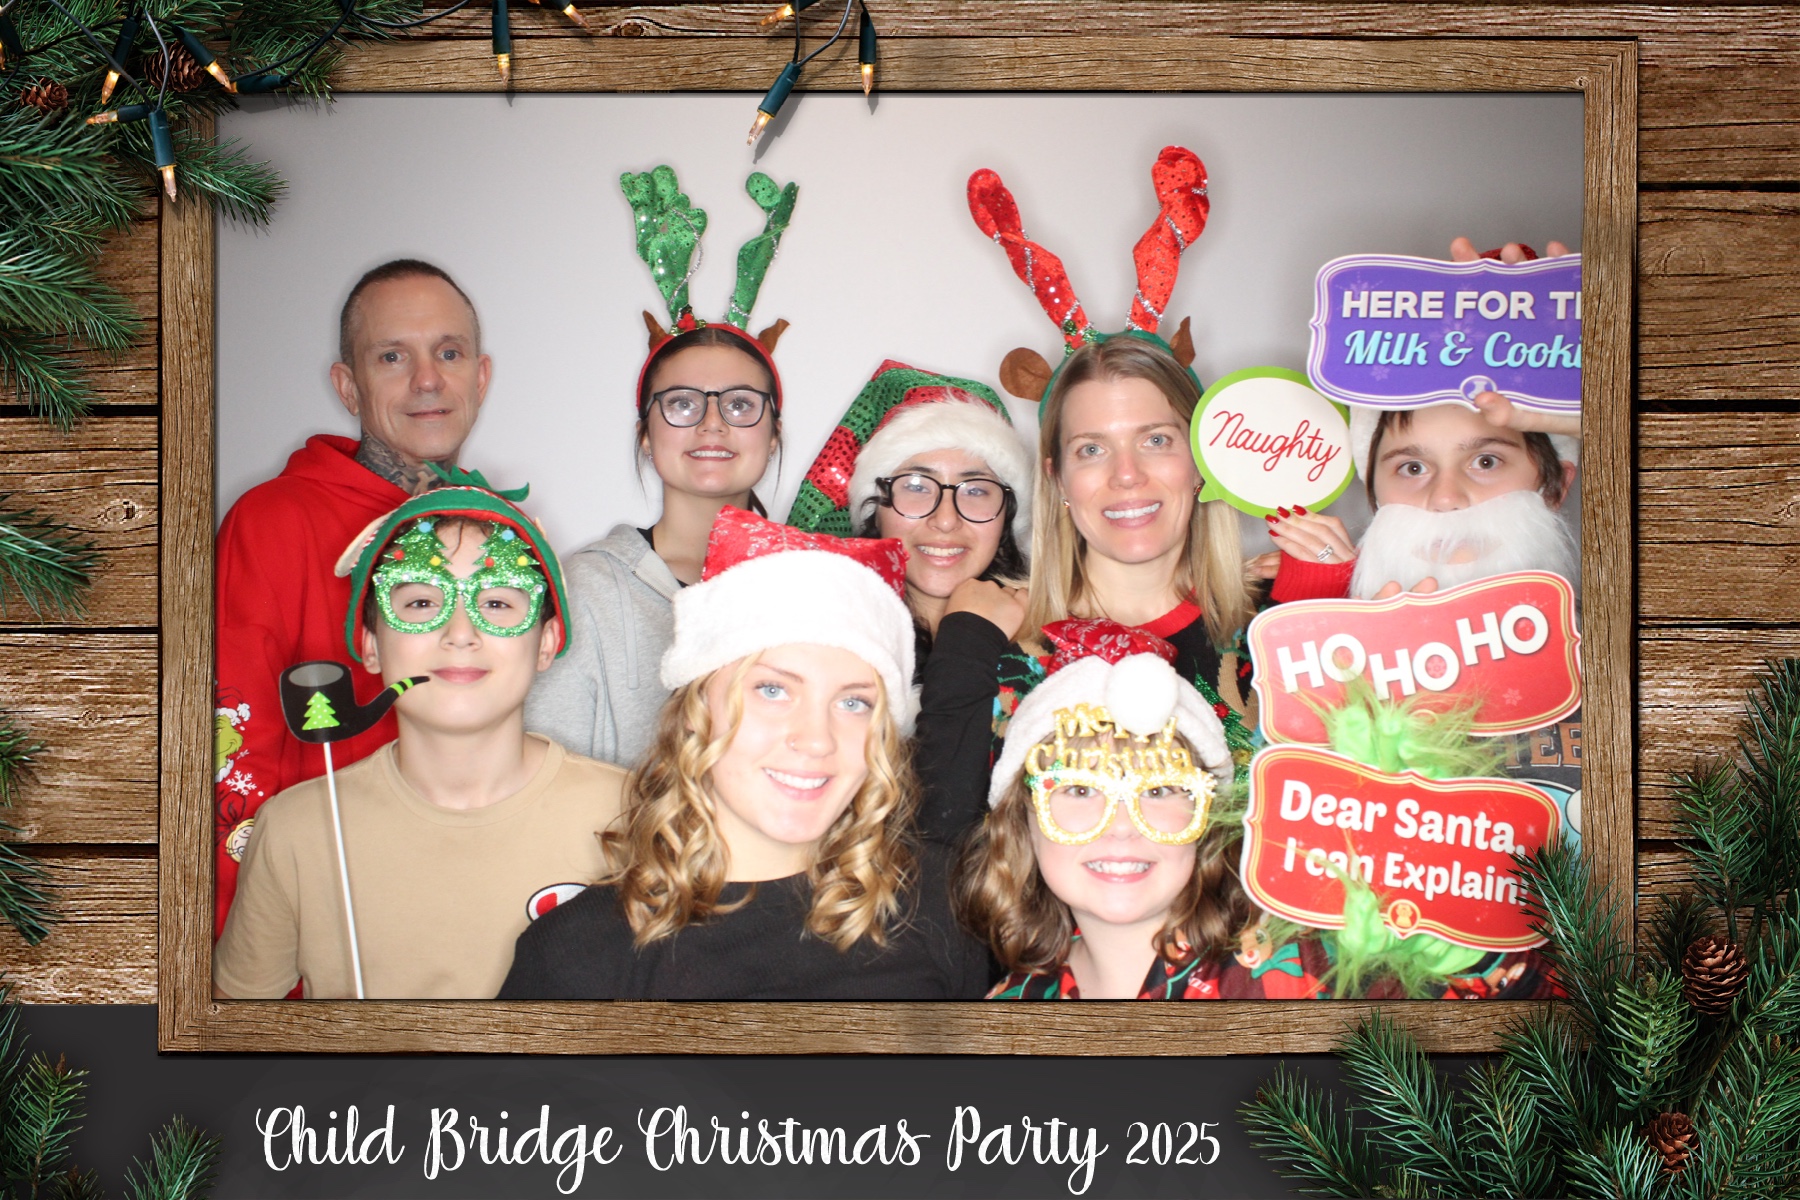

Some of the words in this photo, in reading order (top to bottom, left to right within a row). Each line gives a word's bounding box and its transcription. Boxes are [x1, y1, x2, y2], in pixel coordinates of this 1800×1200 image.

[1342, 291, 1444, 319] HERE
[1454, 291, 1535, 320] FOR
[1549, 291, 1582, 320] T
[1344, 330, 1429, 366] Milk
[1439, 331, 1474, 367] &
[1209, 410, 1341, 482] Naughty
[1276, 633, 1367, 694] HO
[1369, 641, 1460, 701] HO
[1456, 604, 1549, 666] HO
[1280, 779, 1388, 833] Dear
[1283, 836, 1297, 873] I
[1305, 847, 1375, 885] can
